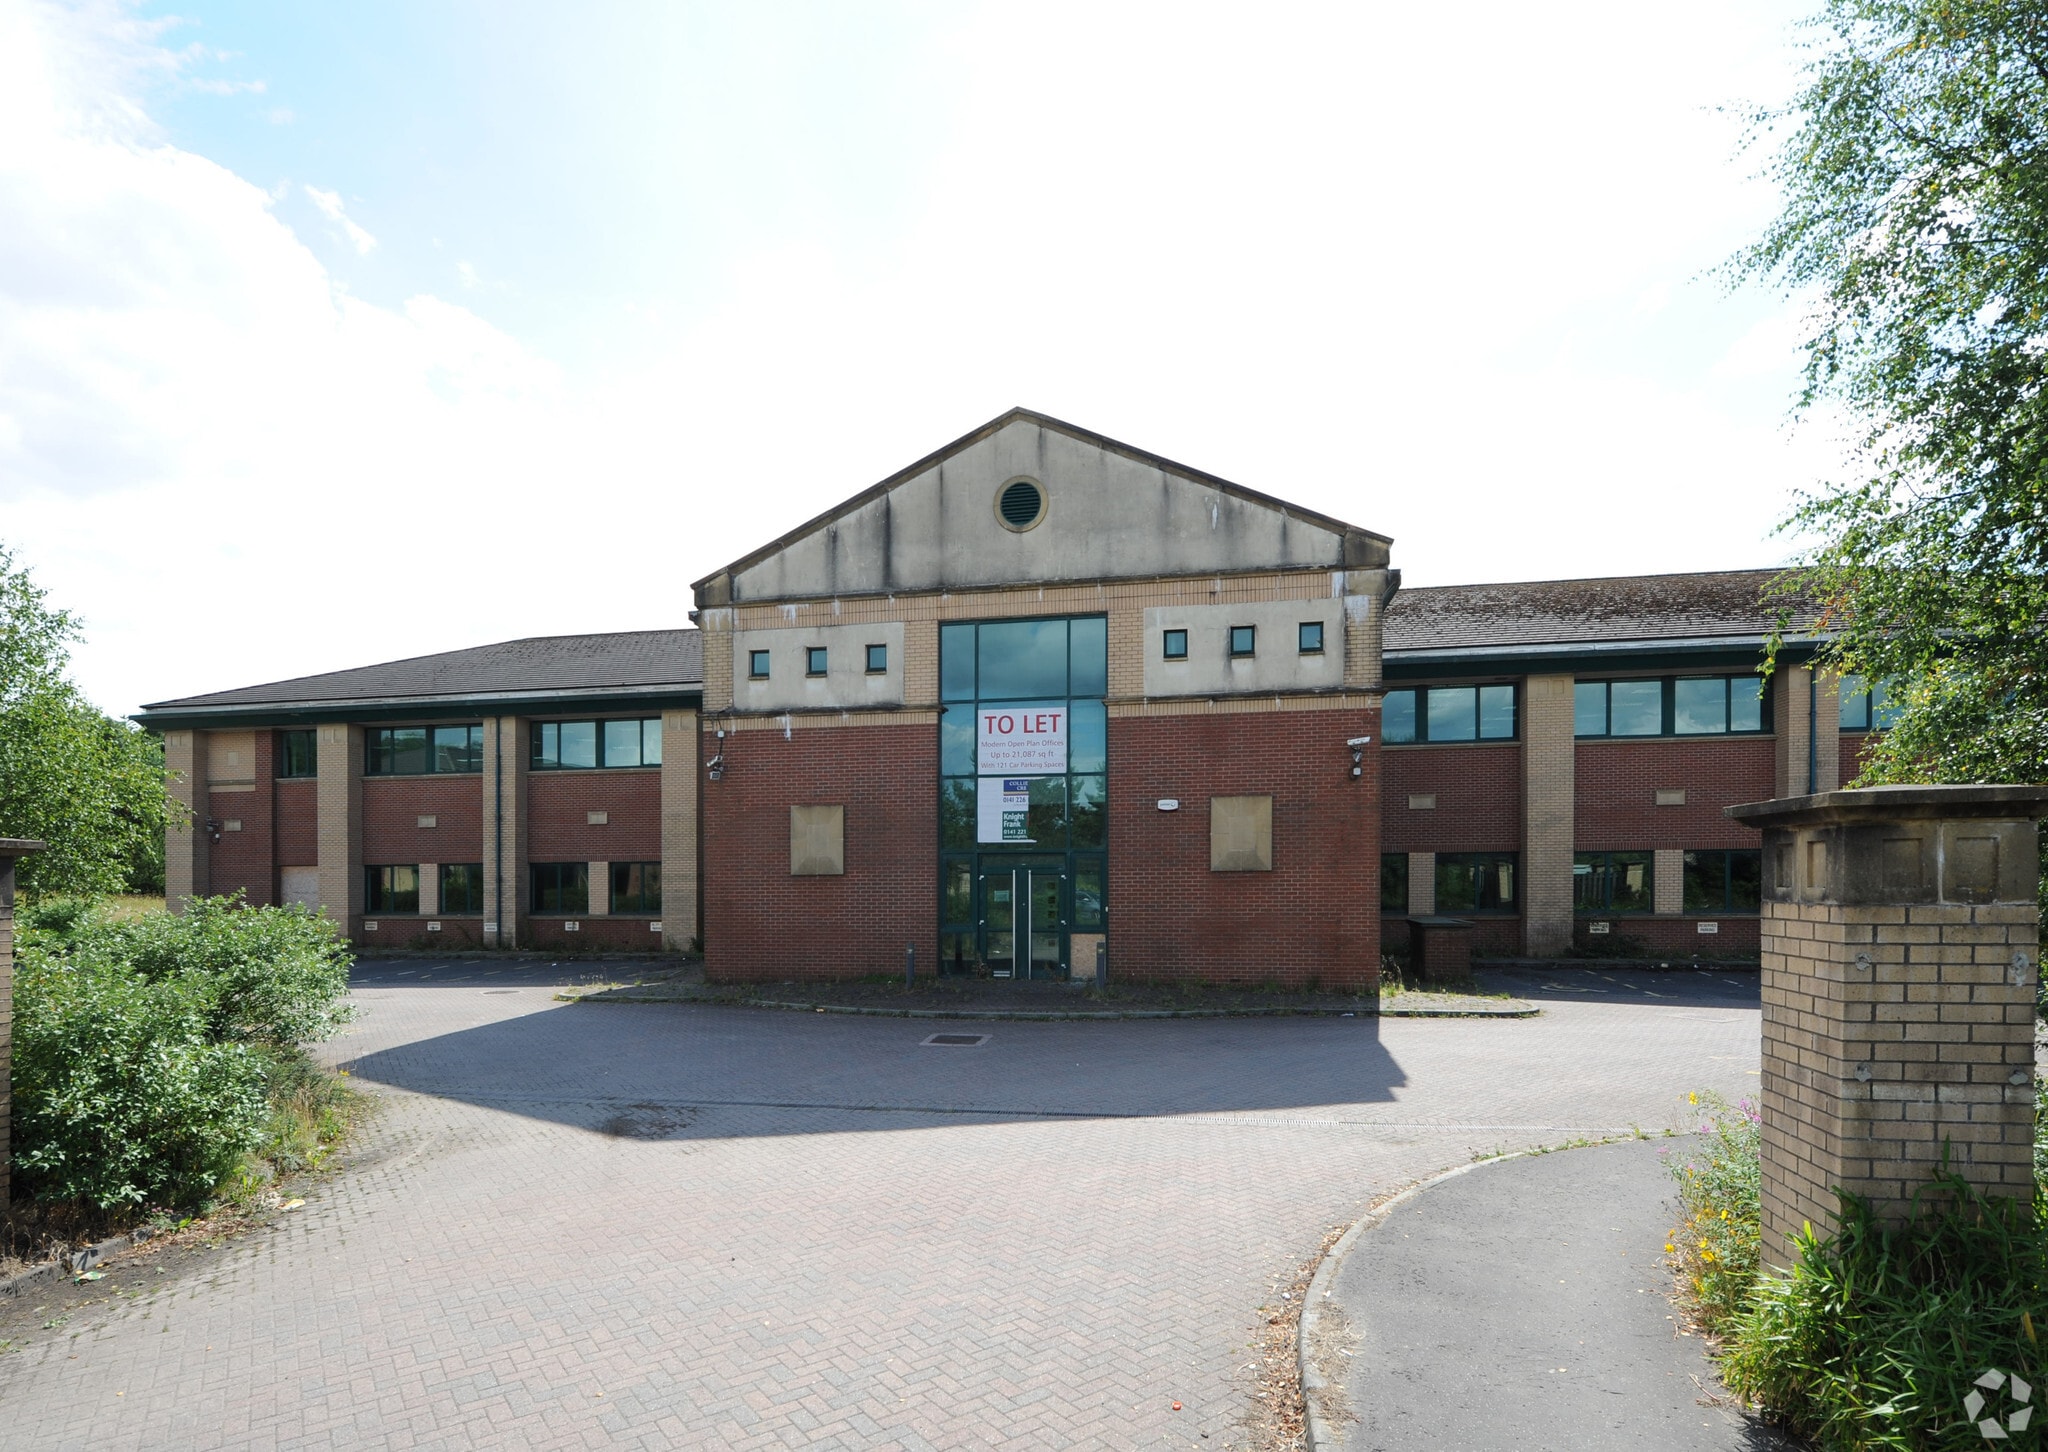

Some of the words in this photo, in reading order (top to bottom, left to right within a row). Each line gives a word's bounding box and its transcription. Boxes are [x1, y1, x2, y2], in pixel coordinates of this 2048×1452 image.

[984, 715, 1014, 734] TO
[1023, 714, 1061, 733] LET
[1007, 740, 1025, 748] Open
[990, 751, 1001, 759] Up
[1012, 750, 1036, 759] 21,087
[1020, 761, 1042, 769] Parking
[1003, 813, 1024, 821] Knight
[1003, 820, 1022, 828] Frank
